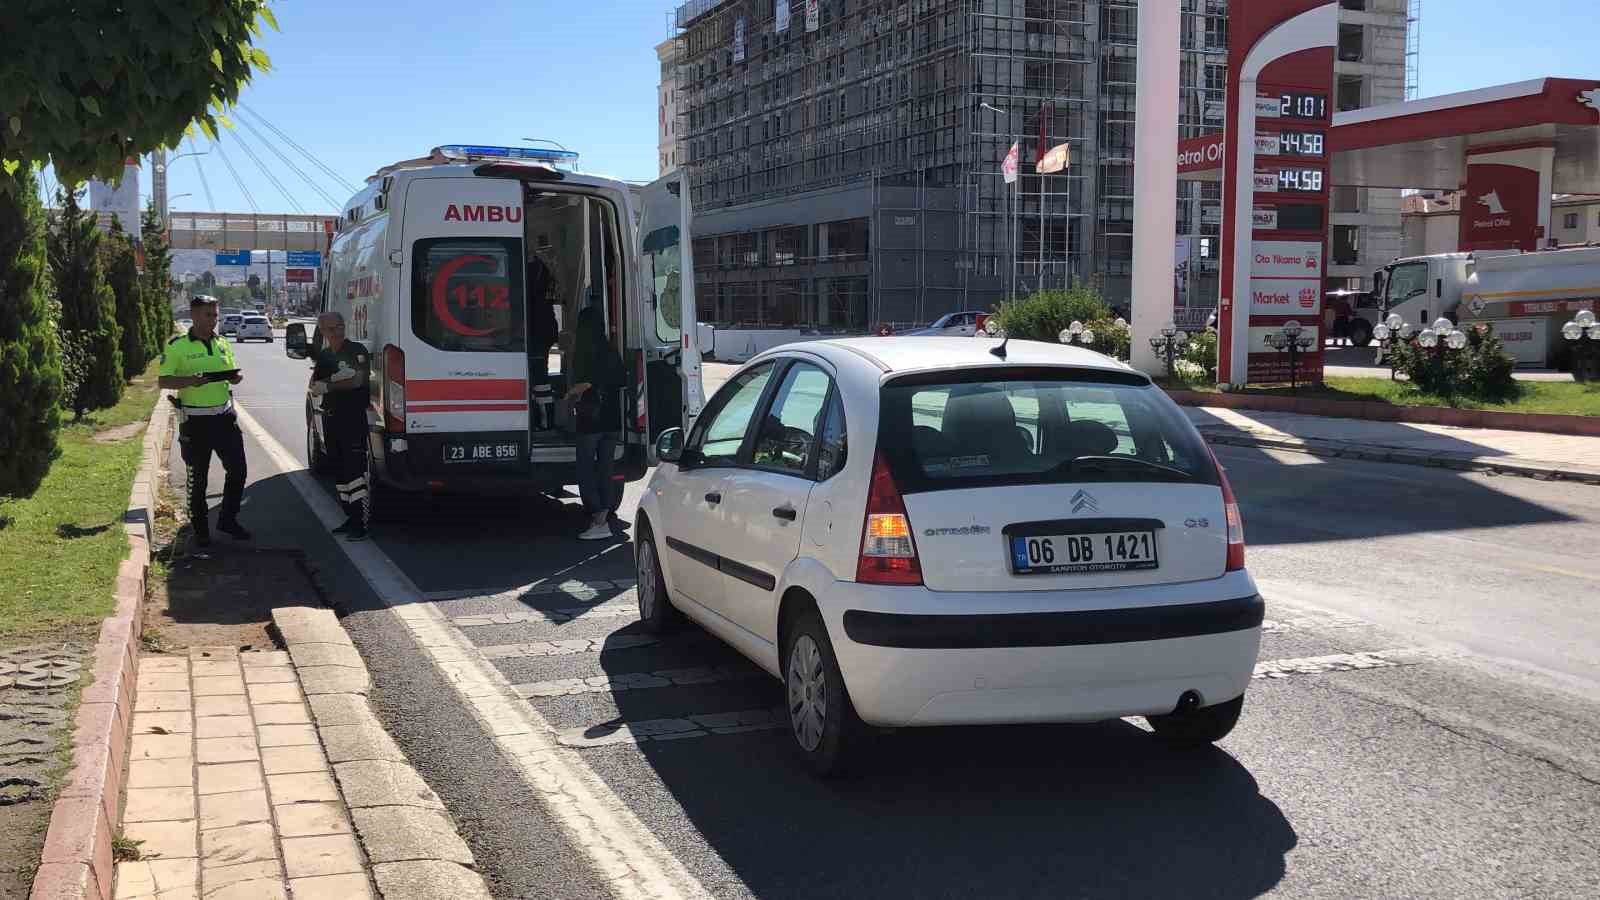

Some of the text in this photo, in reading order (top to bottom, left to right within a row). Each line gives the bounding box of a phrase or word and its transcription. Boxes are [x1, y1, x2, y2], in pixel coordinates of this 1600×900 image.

[1281, 95, 1324, 117] 21.01
[1177, 142, 1224, 165] etrol Of
[1280, 133, 1323, 154] 44.58
[1279, 170, 1322, 191] 44.58
[444, 204, 522, 223] AMBU
[1255, 254, 1270, 264] Oto
[453, 284, 512, 310] 112
[1253, 291, 1290, 304] Market
[451, 445, 516, 459] 23 ABE 856
[1028, 538, 1055, 564] 06
[1067, 536, 1093, 562] DB
[1104, 533, 1150, 561] 1421
